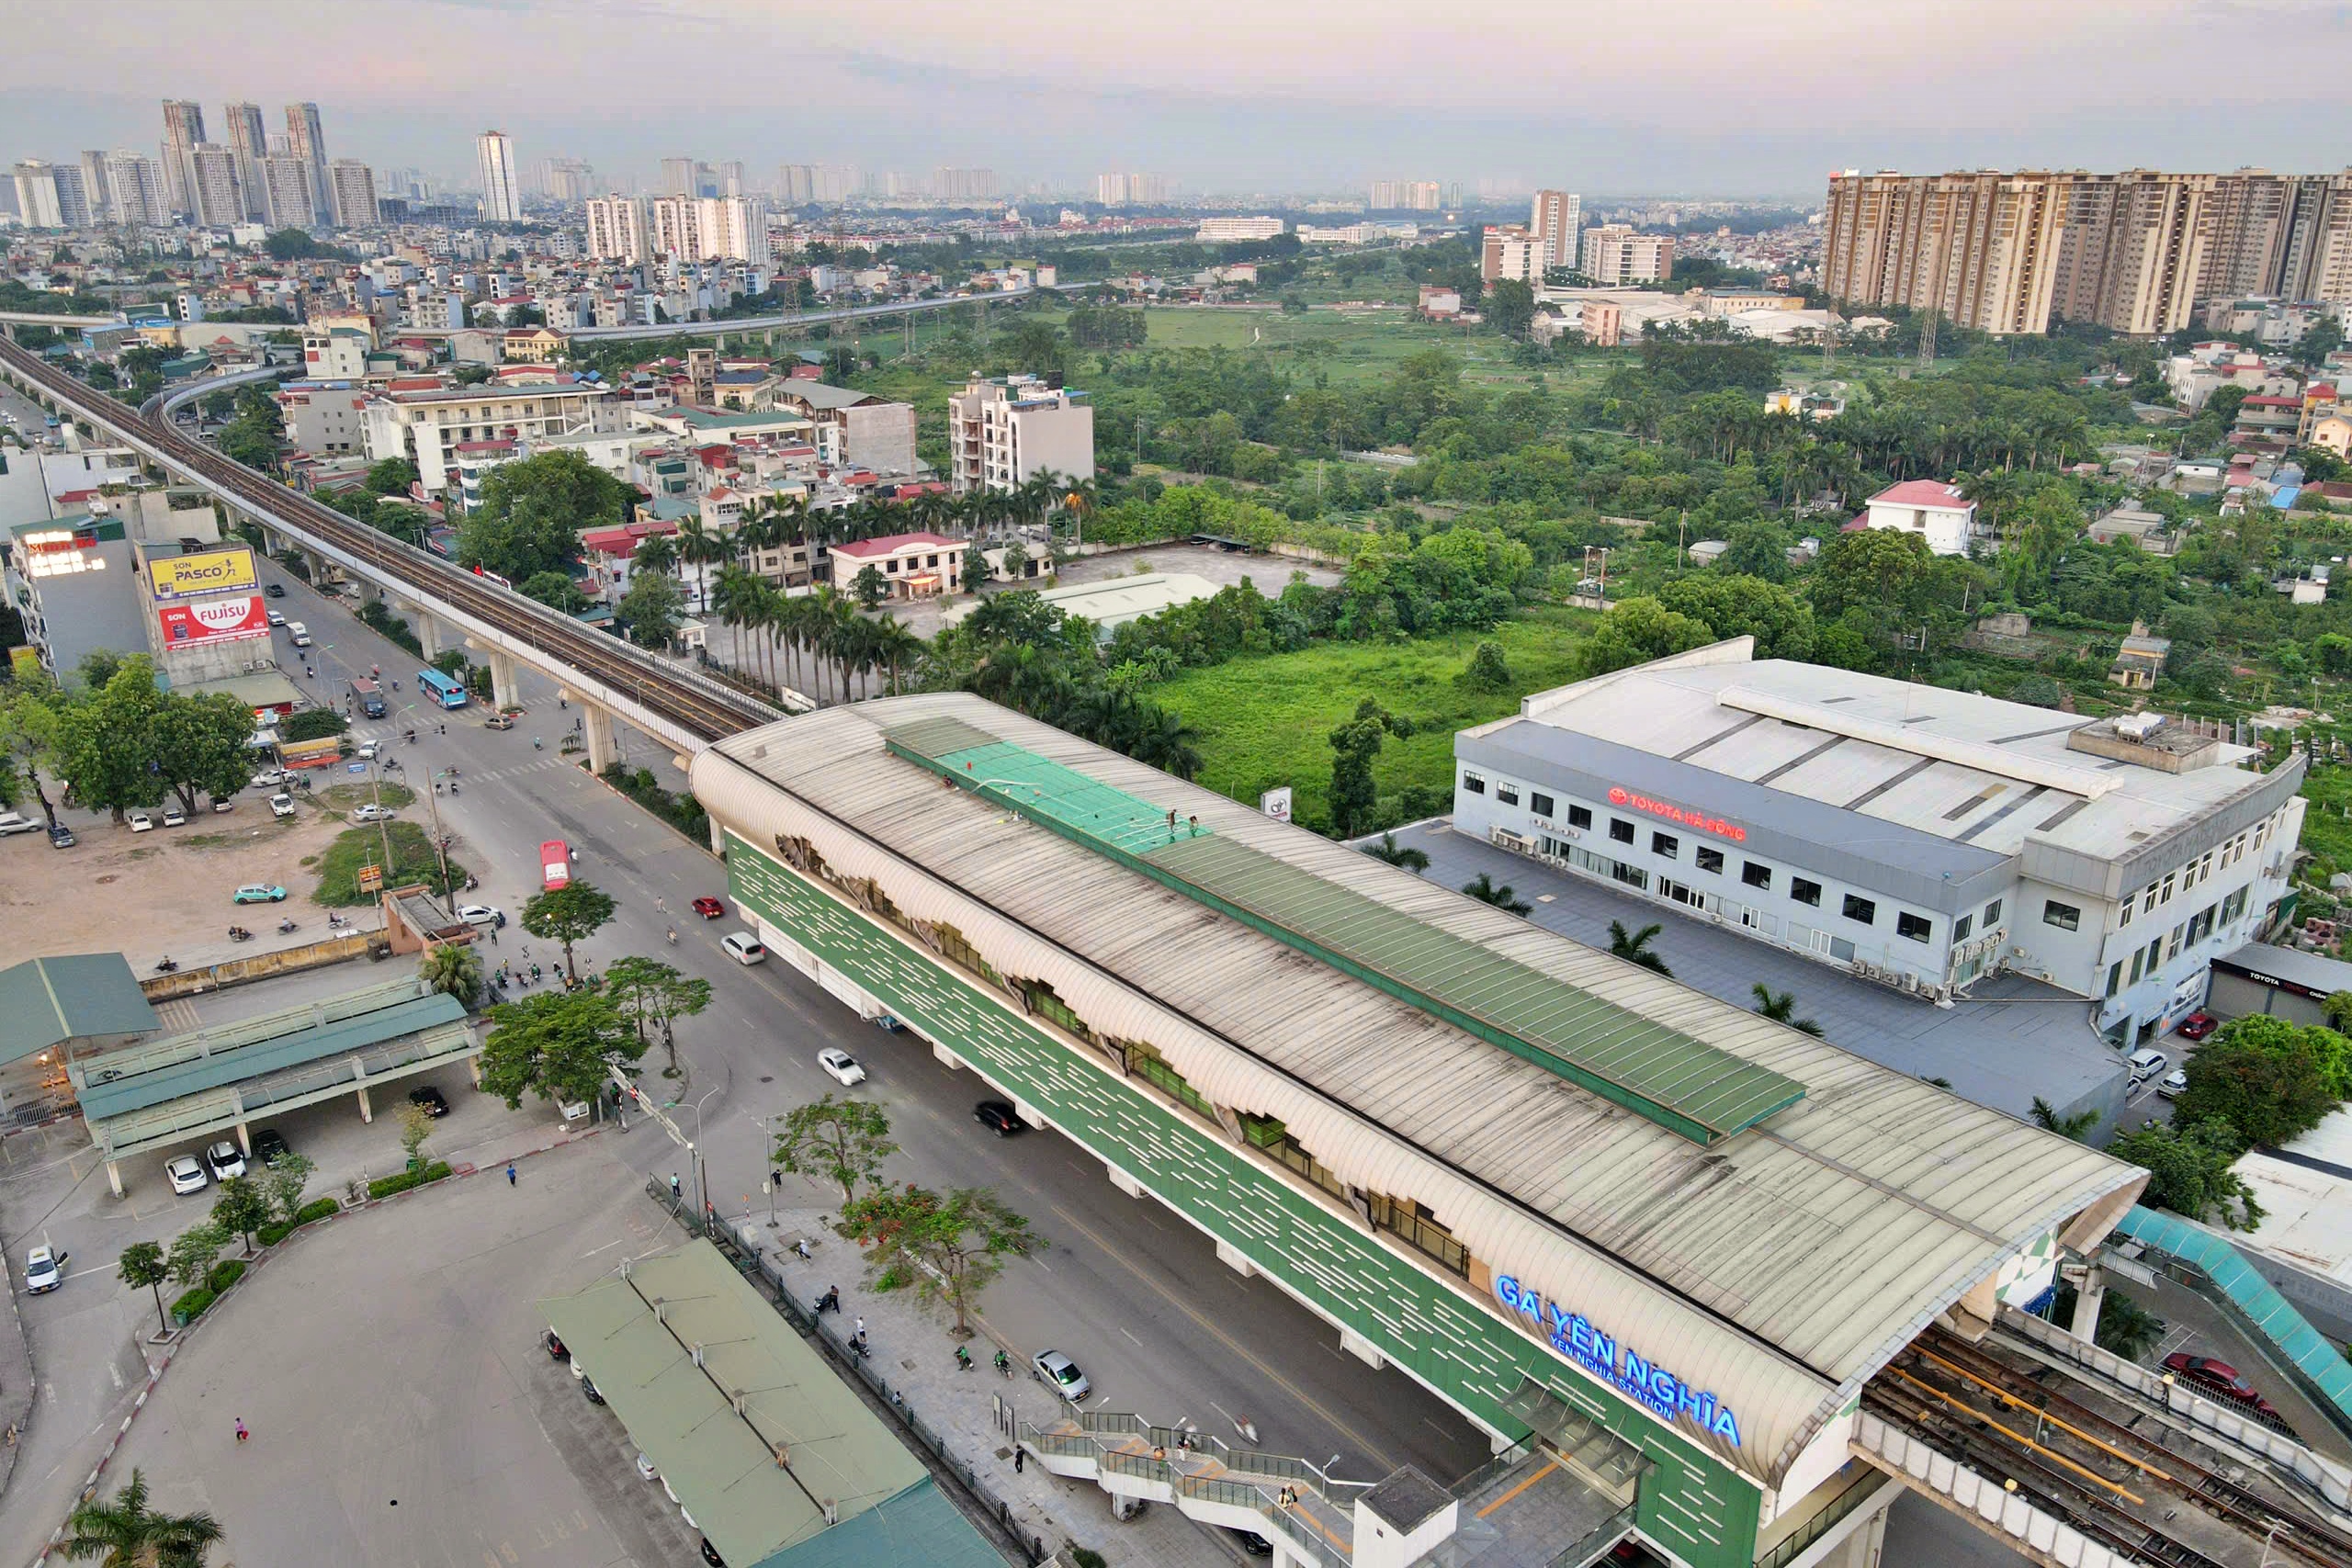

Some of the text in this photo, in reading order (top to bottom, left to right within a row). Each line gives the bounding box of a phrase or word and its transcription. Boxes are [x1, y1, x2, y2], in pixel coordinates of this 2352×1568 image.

[175, 568, 221, 581] PASCO
[1630, 795, 1681, 821] TOYOTA
[2250, 973, 2279, 986] TOYOTA
[1497, 1275, 1740, 1447] GA YÊN NGHĨA
[1550, 1334, 1673, 1421] YEN NGHIA STATION
